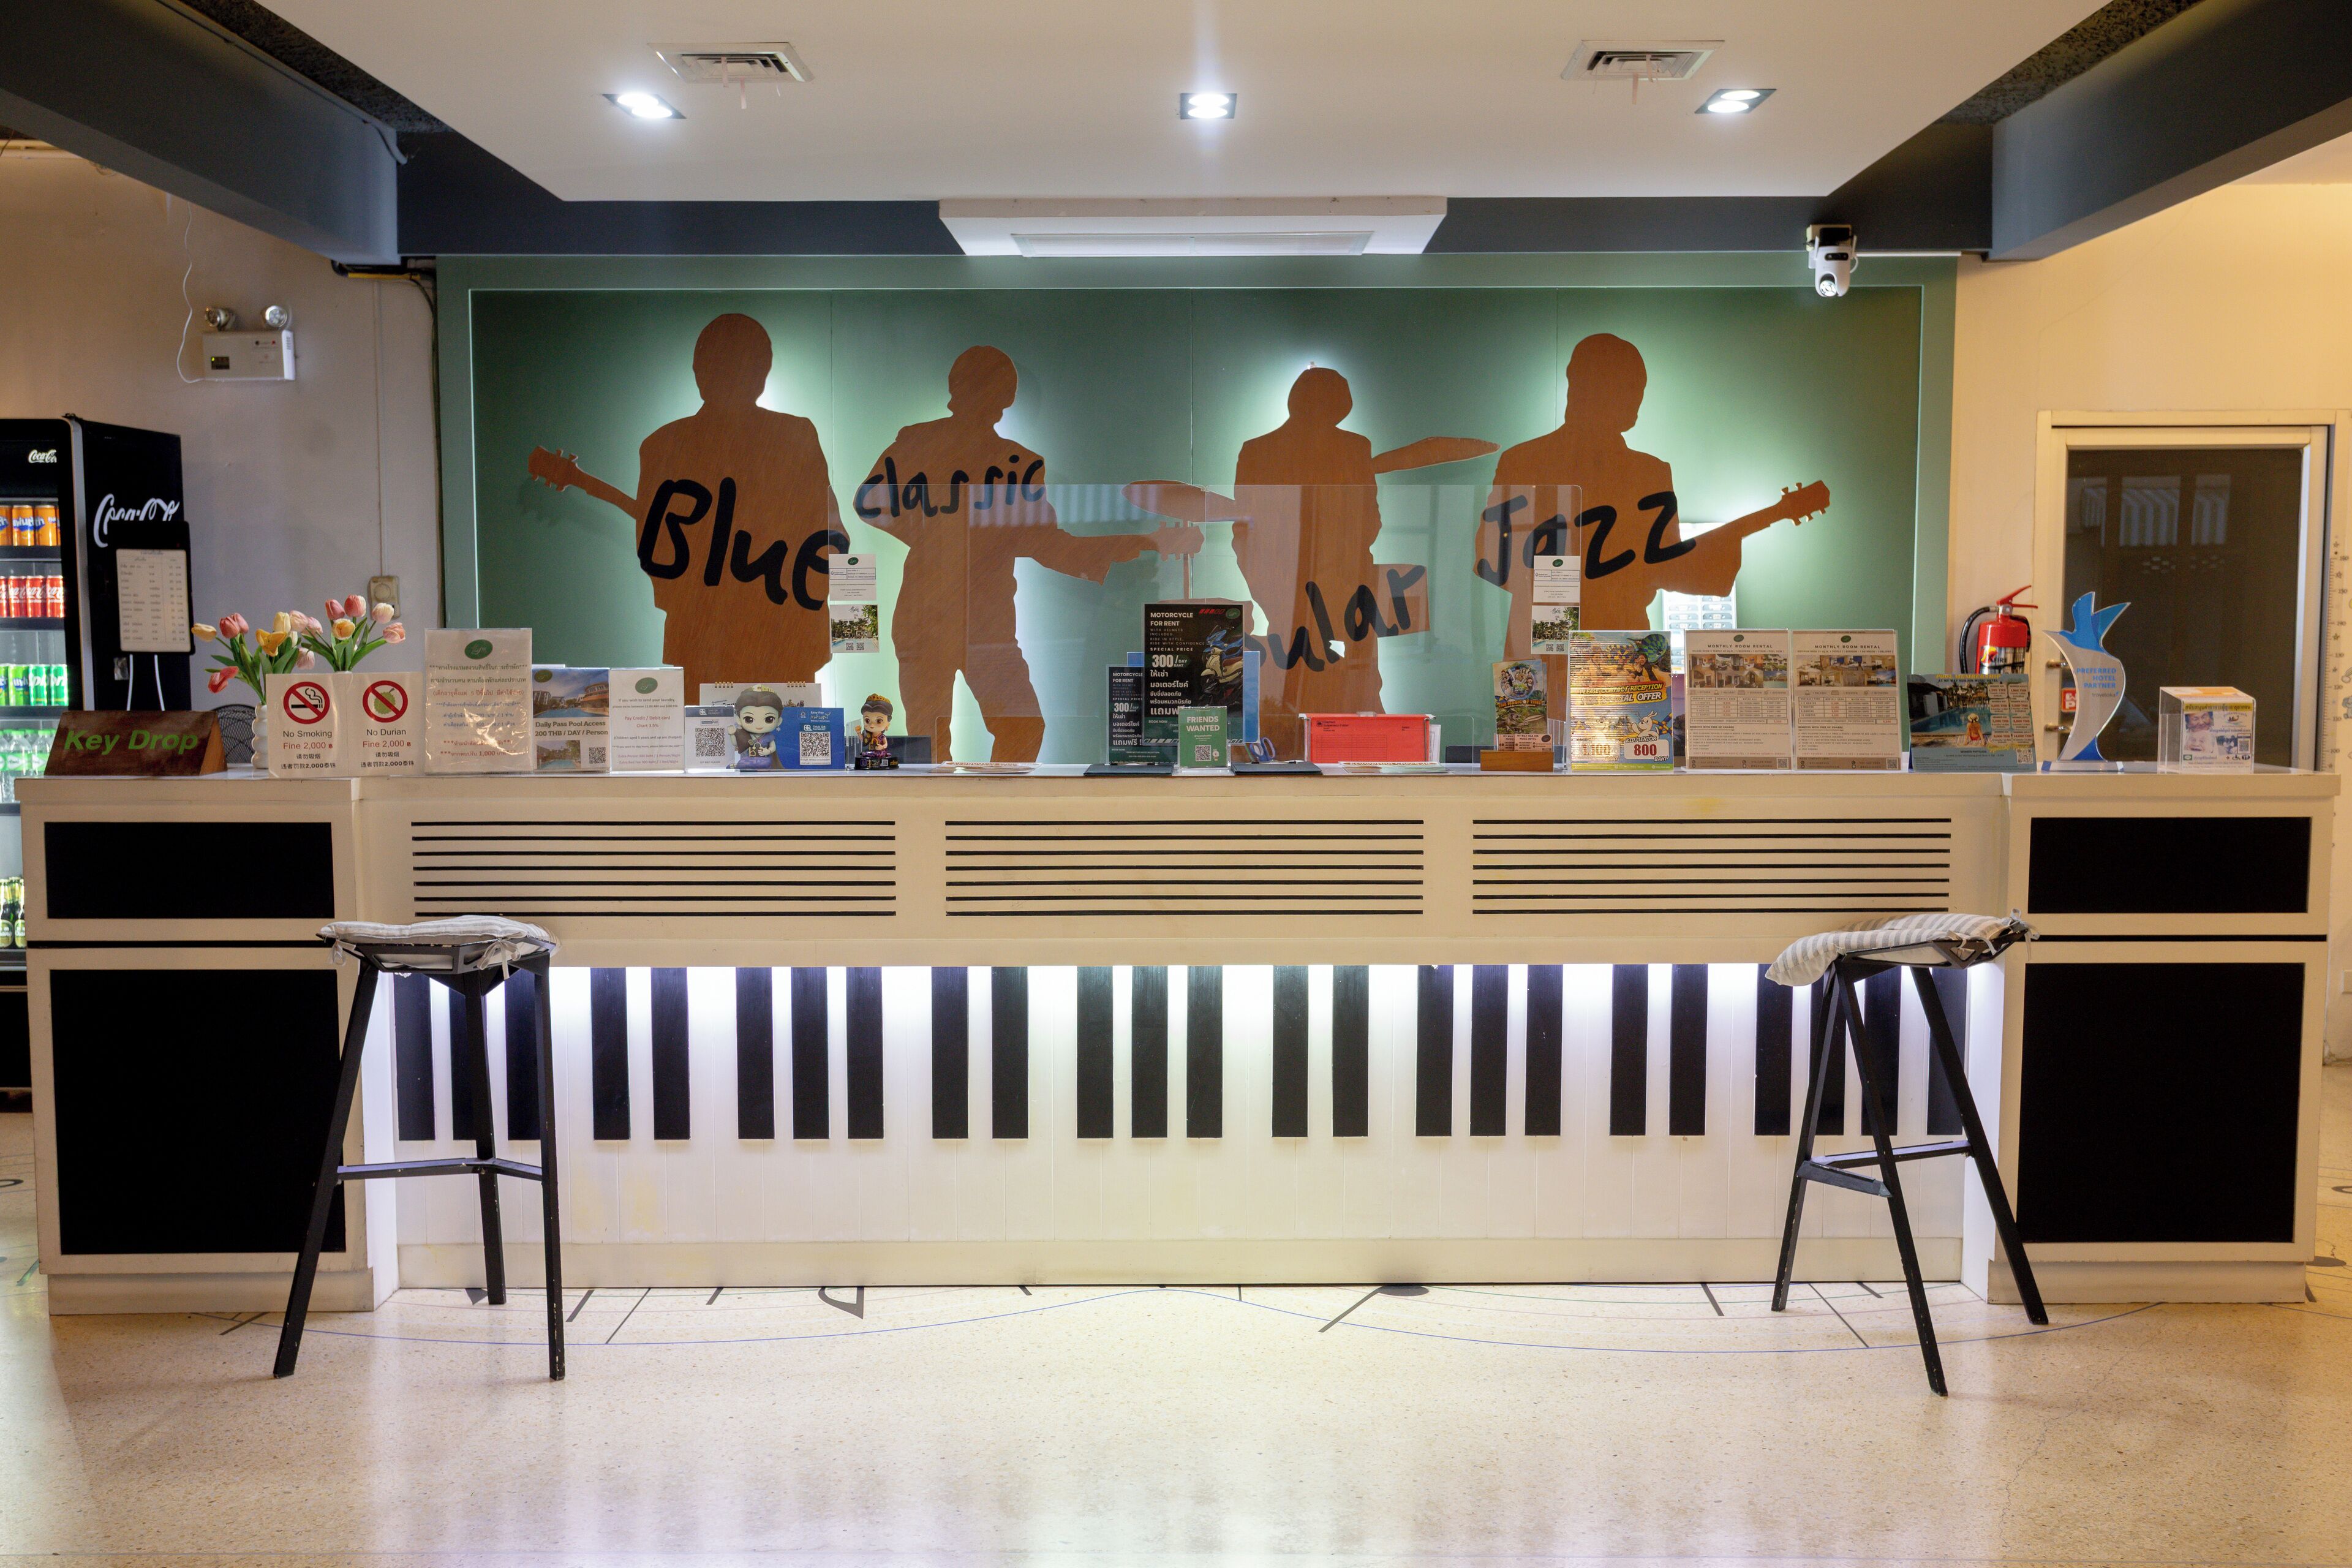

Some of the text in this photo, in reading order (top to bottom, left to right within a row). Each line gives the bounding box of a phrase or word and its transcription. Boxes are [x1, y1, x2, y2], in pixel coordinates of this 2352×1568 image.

[638, 477, 850, 611] Blue
[1152, 654, 1174, 668] 300
[1637, 692, 1662, 701] OFFER
[1114, 703, 1129, 712] 300
[297, 730, 333, 739] Smoking
[64, 729, 198, 755] Key Drop
[1634, 744, 1657, 756] 800
